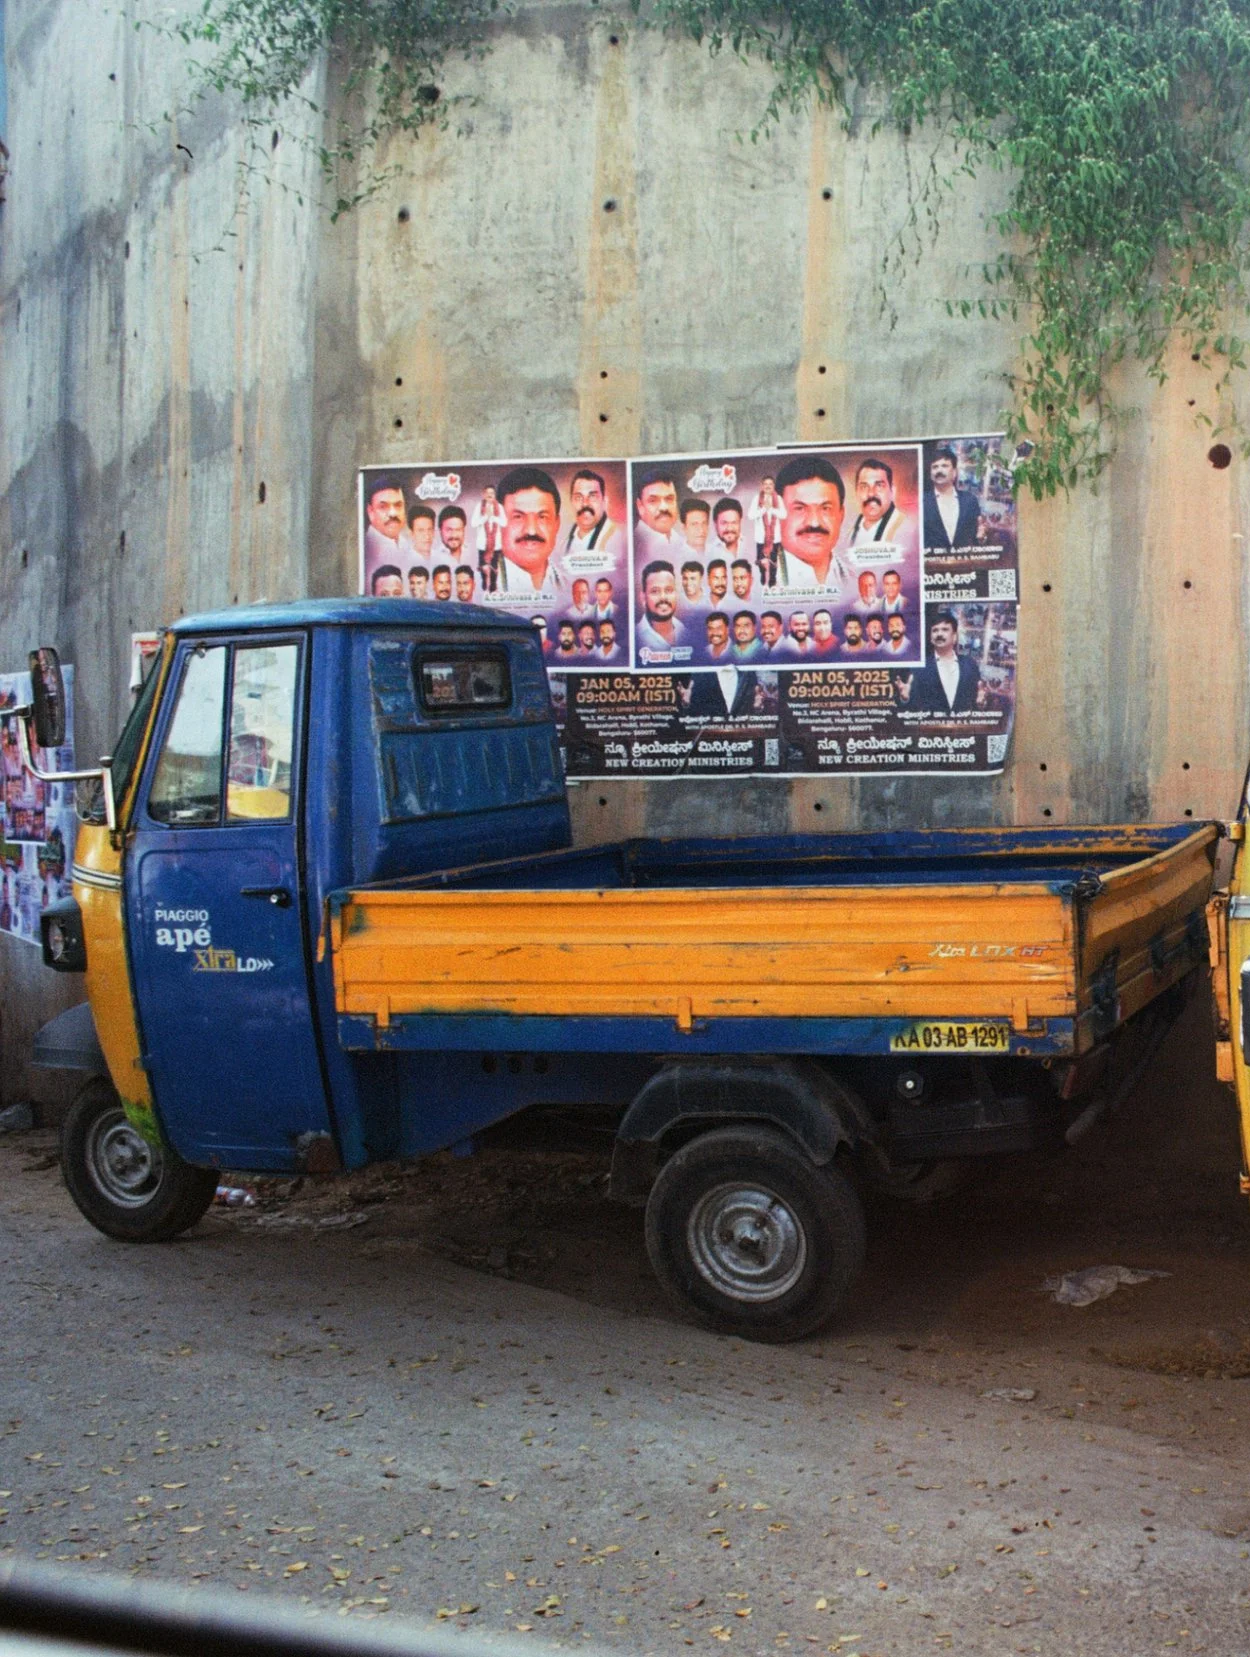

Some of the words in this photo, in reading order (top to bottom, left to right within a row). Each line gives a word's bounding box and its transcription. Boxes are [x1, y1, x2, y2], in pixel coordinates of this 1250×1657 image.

[924, 589, 977, 599] NISTRIES
[580, 679, 609, 690] JAN
[613, 678, 635, 691] 05,
[639, 677, 673, 689] 2025
[792, 673, 823, 684] JAN
[827, 672, 849, 685] 05,
[853, 671, 890, 683] 2025
[576, 691, 640, 703] 09:00AM
[645, 690, 676, 703] (IST)
[788, 685, 855, 698] 09:00AM
[859, 684, 894, 698] (IST)
[605, 758, 629, 767] NEW
[631, 757, 685, 767] CREATION
[688, 756, 753, 766] MINISTRIES
[819, 755, 842, 764] NEW
[846, 754, 905, 764] CREATION
[908, 753, 976, 763] MINISTRIES
[155, 909, 209, 922] PIAGGIO
[156, 922, 211, 952] apé
[895, 1028, 920, 1048] KA
[923, 1026, 942, 1047] 03
[946, 1026, 968, 1047] AB
[972, 1025, 1007, 1047] 1291
